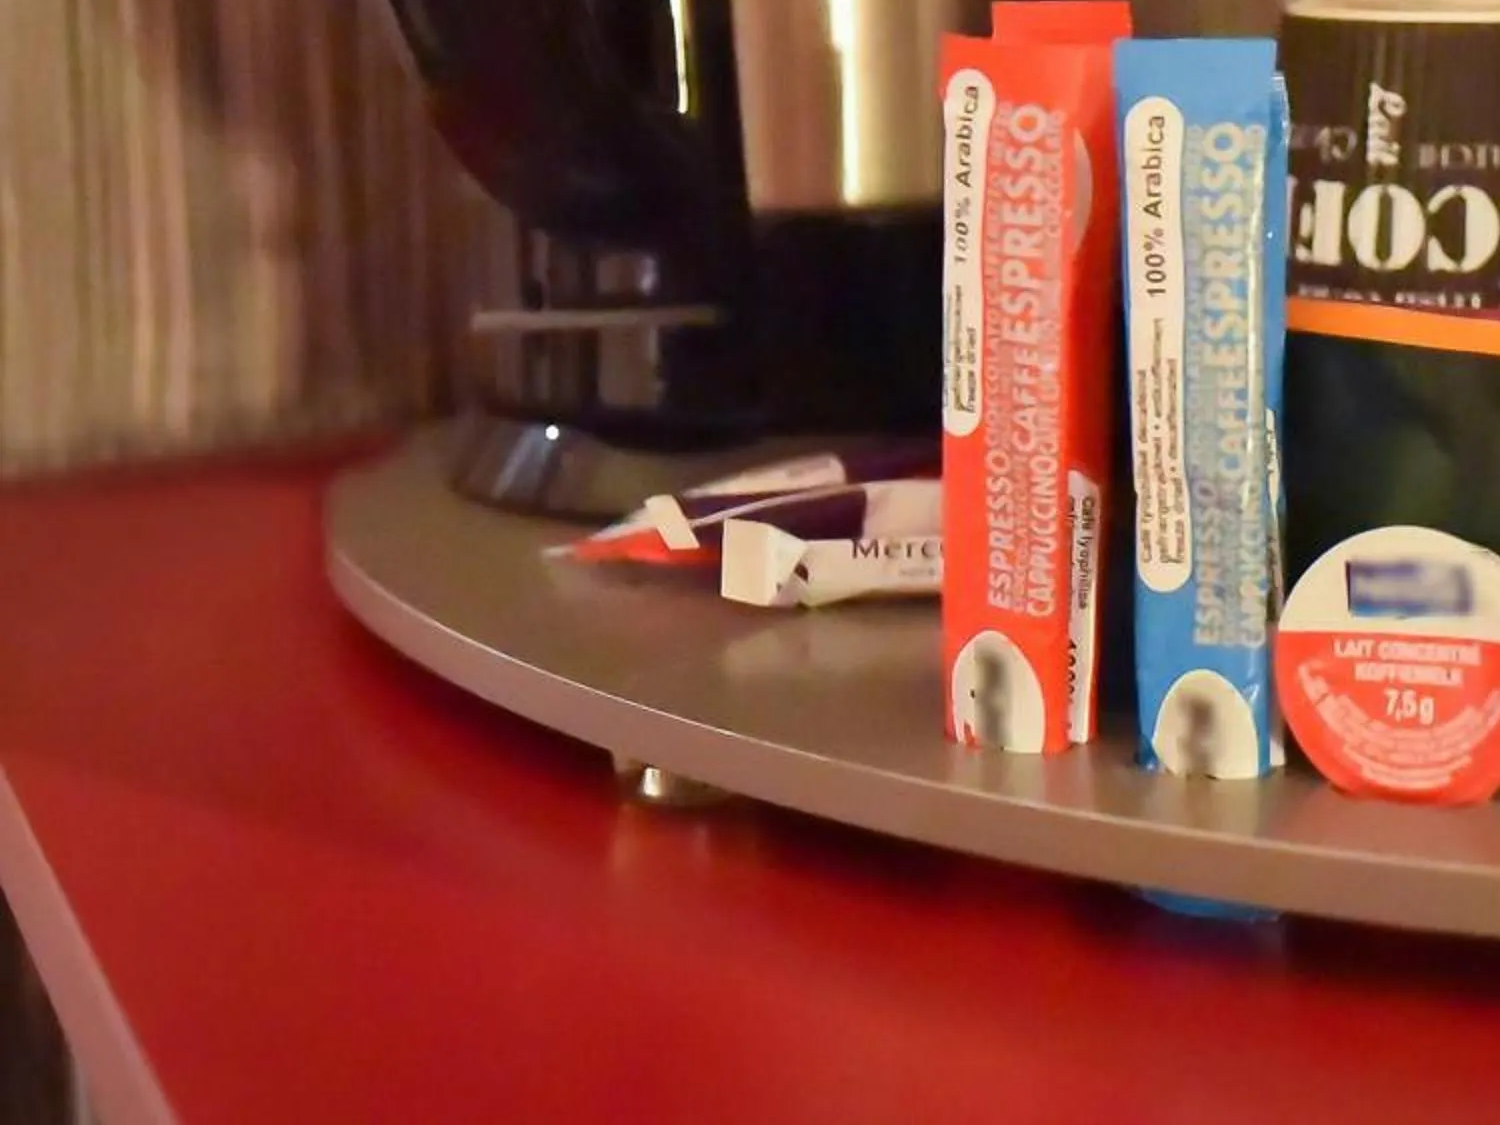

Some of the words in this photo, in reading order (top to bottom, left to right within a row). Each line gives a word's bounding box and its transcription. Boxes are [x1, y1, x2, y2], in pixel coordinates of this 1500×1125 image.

[954, 86, 979, 188] Arabica
[1142, 115, 1166, 219] Arabica
[953, 198, 970, 265] 100%
[998, 104, 1048, 345] ESPRESSO
[1143, 228, 1166, 298] 100%
[1200, 122, 1249, 367] ESPRESSO
[984, 449, 1014, 610] ESPRESSO
[1026, 455, 1058, 617] CAPPUCCINO
